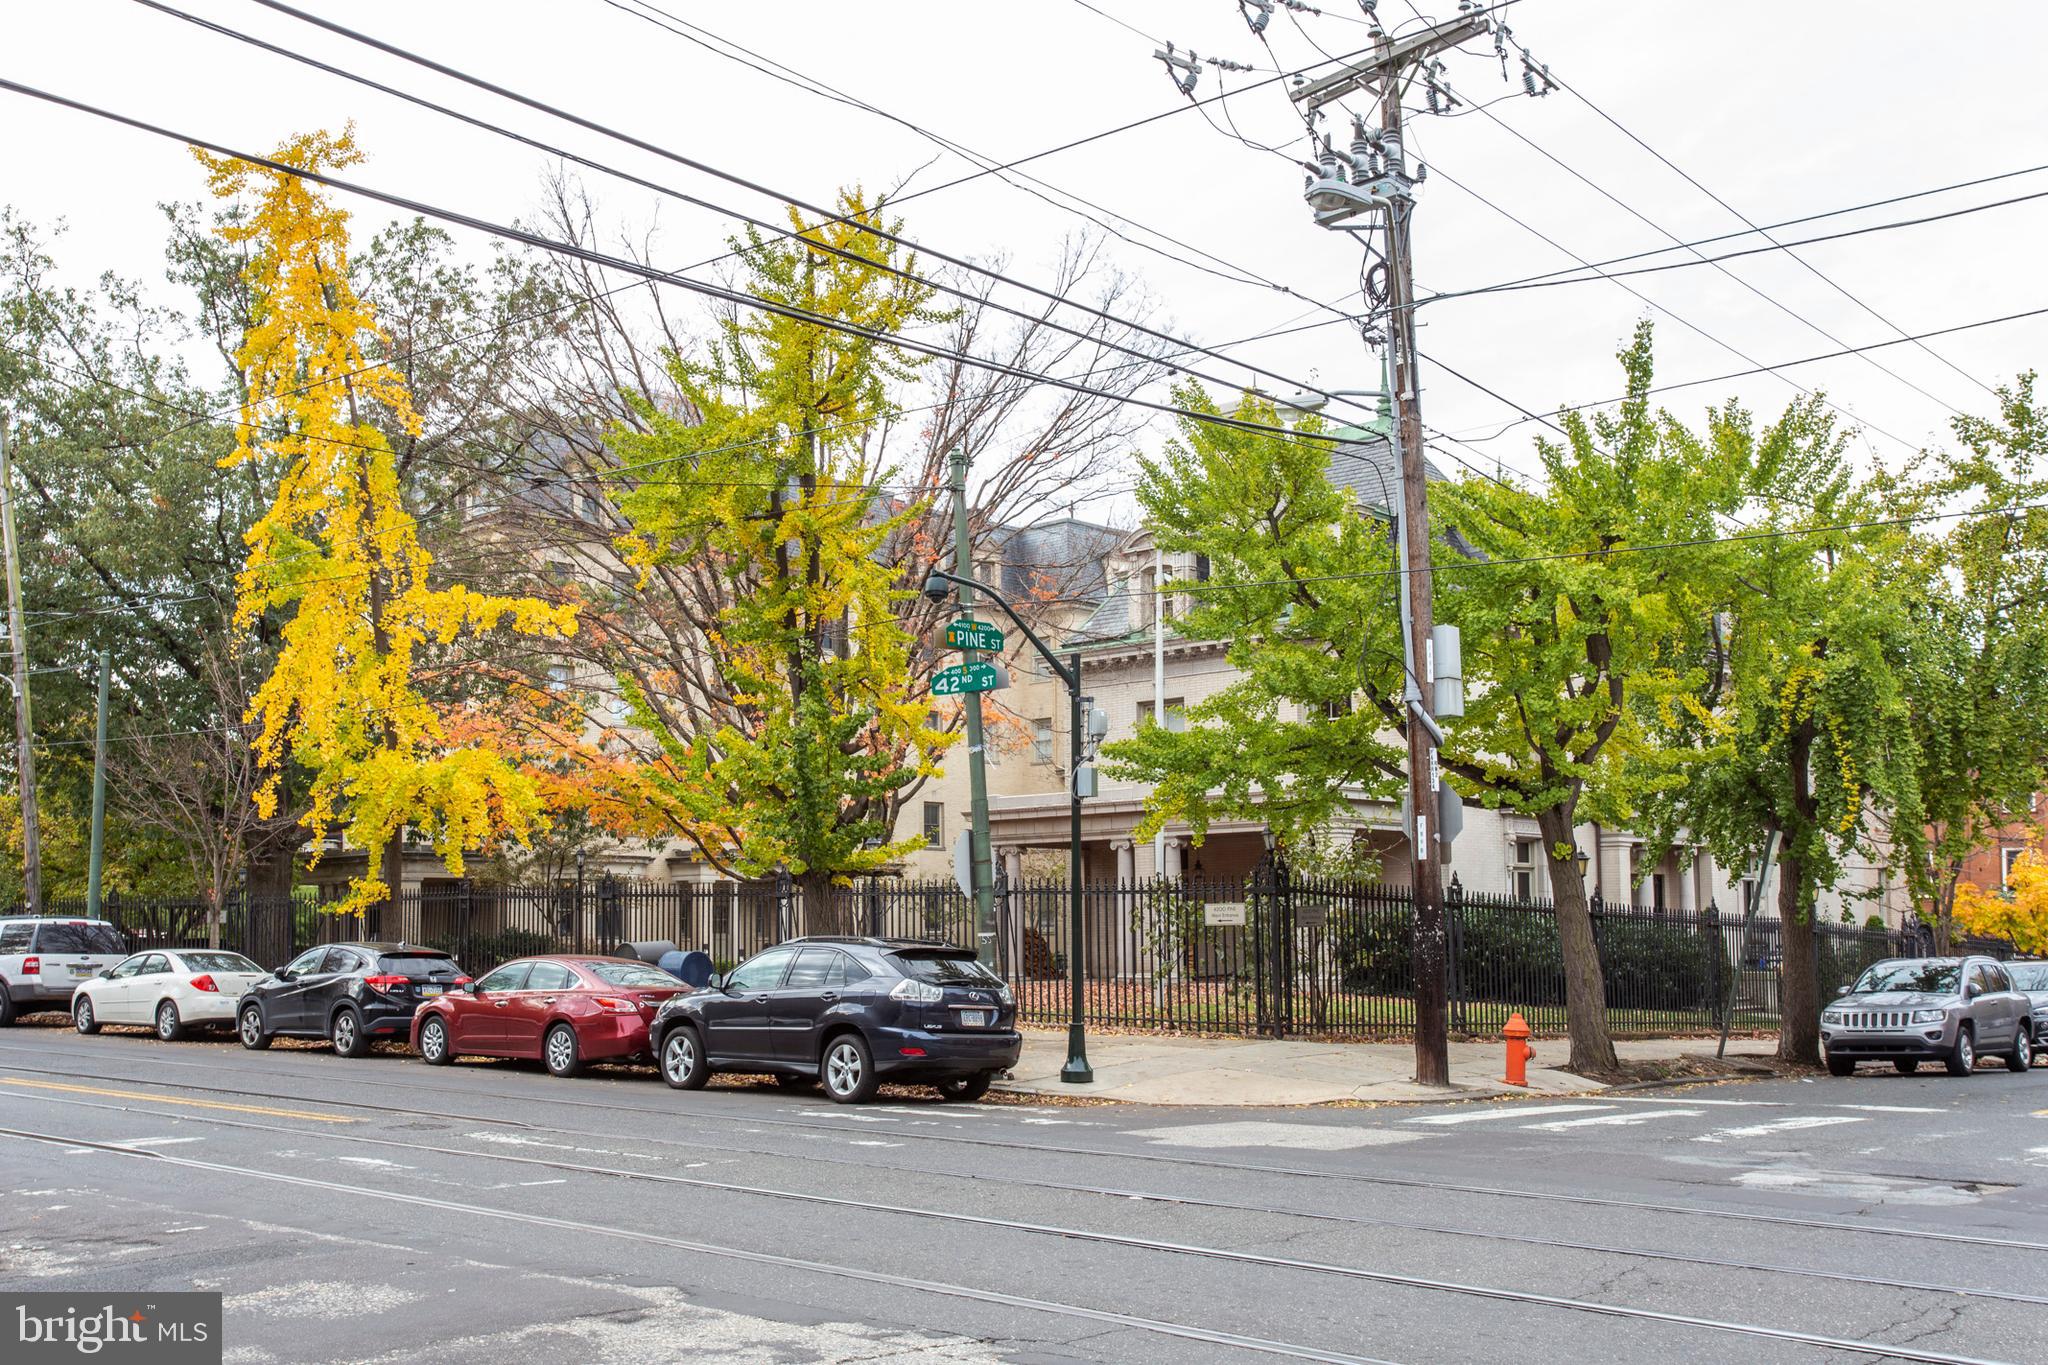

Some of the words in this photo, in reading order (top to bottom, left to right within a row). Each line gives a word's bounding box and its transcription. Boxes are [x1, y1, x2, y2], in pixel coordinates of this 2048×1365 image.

[957, 631, 986, 648] PINE
[991, 639, 1001, 650] ST
[981, 675, 994, 687] ST
